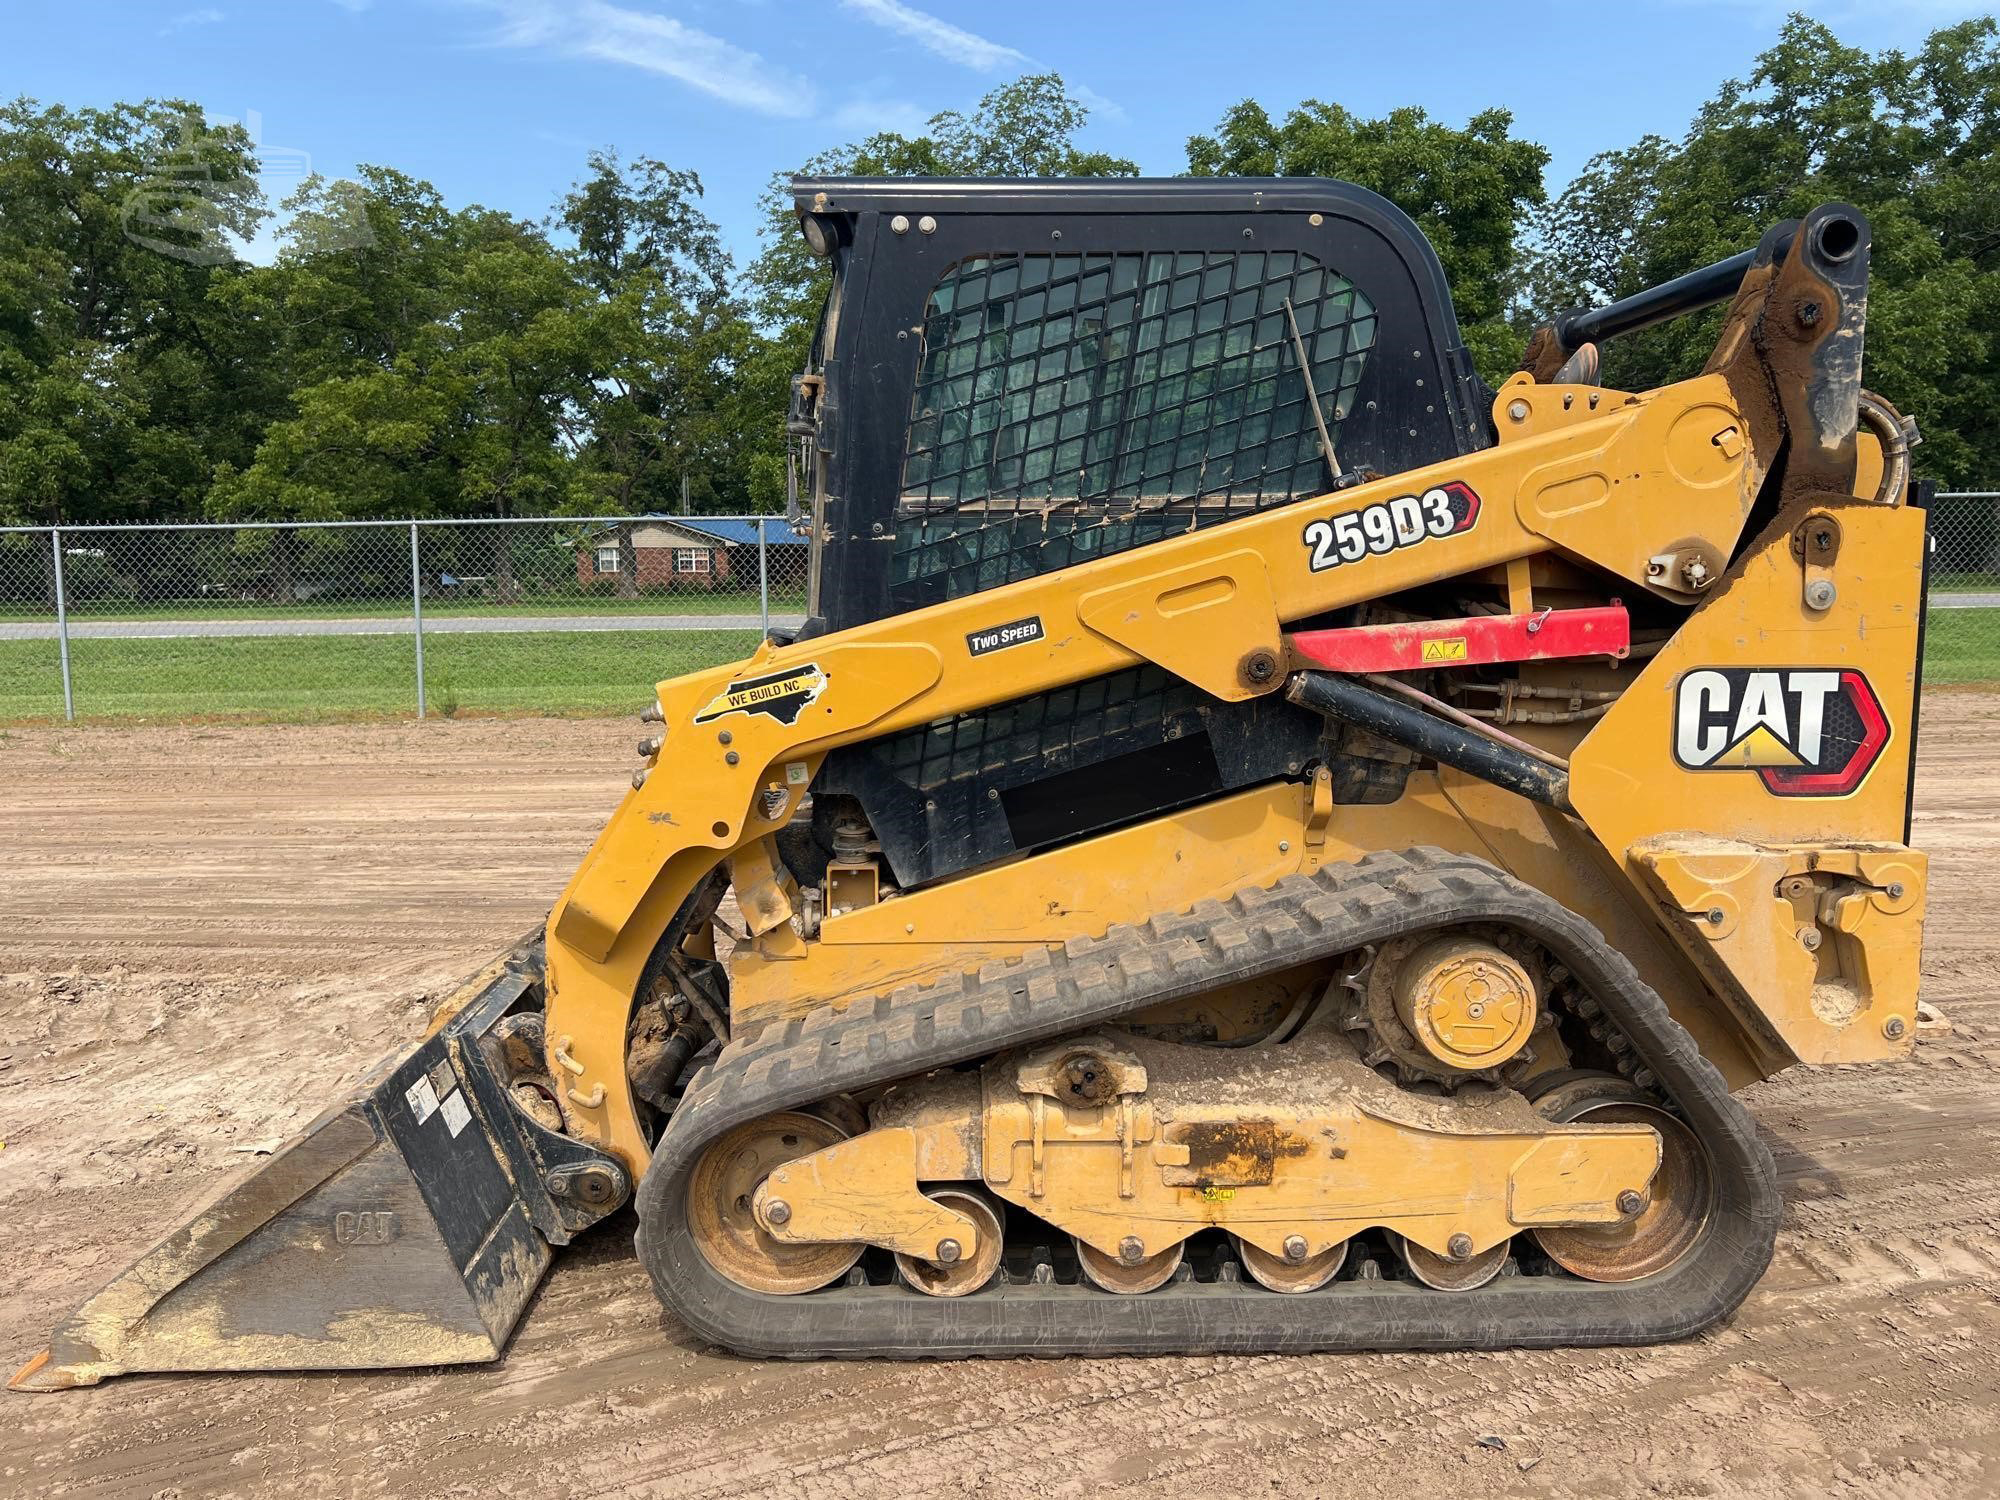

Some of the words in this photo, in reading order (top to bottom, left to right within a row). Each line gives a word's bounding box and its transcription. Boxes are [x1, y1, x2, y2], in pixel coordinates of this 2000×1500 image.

[1305, 489, 1455, 569] 259D3
[728, 694, 747, 706] WE
[750, 685, 781, 702] BUILD
[784, 680, 800, 692] NC
[1677, 670, 1840, 766] CAT
[335, 1211, 394, 1245] CAT
